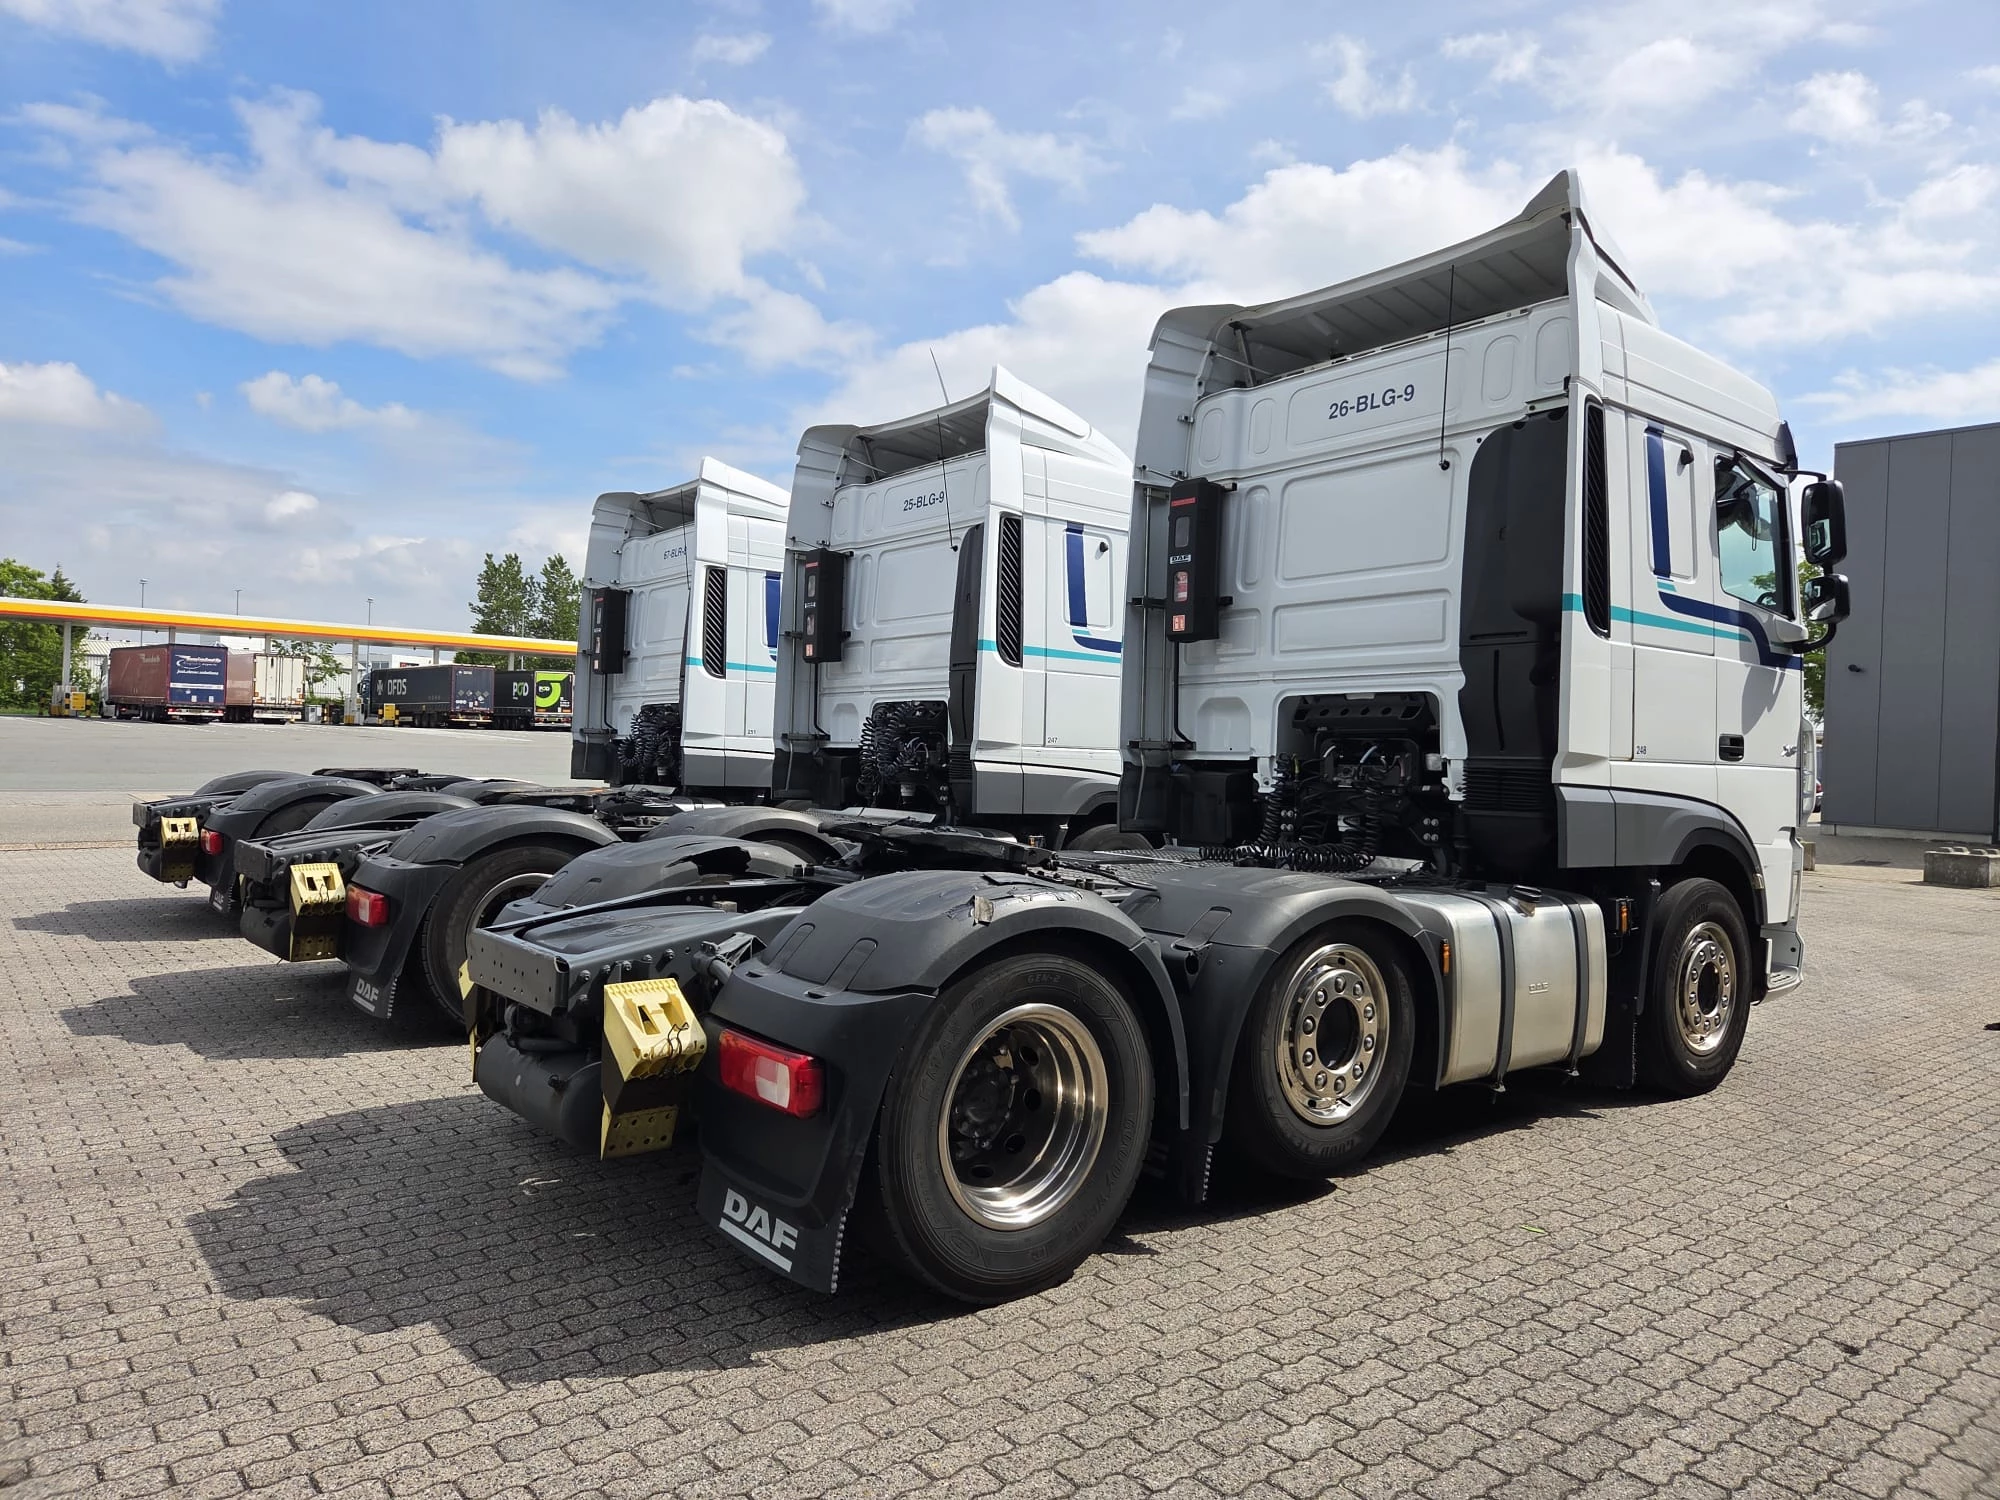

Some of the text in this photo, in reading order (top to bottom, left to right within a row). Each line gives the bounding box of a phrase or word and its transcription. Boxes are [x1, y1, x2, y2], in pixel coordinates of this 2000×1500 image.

[1328, 383, 1415, 420] 26-BLG-9
[903, 490, 945, 512] 25-BLG-9
[1171, 555, 1190, 564] DAF
[387, 678, 407, 696] DFDS
[1047, 736, 1058, 744] 247
[1636, 745, 1647, 755] 248
[1027, 972, 1062, 984] GEN-2
[356, 977, 380, 1002] DAF
[723, 1187, 799, 1251] DAF
